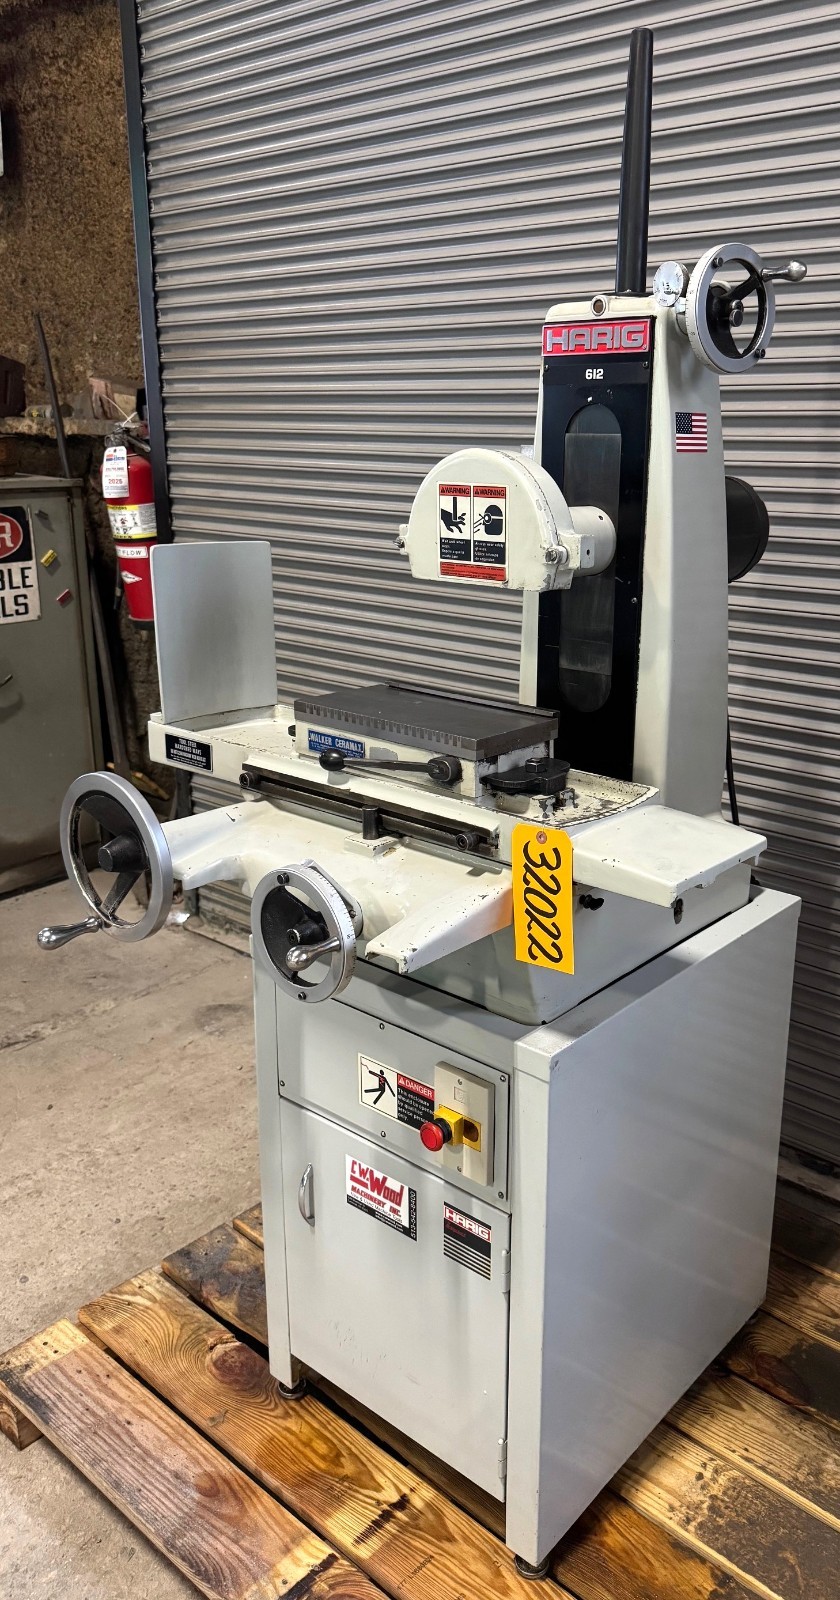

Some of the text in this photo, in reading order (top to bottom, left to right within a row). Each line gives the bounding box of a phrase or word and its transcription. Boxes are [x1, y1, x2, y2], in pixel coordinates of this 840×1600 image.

[547, 324, 644, 352] HARIG
[585, 368, 604, 380] 612
[444, 487, 470, 495] WARNING
[479, 488, 505, 497] WARNING
[310, 732, 332, 746] WALKER
[335, 738, 362, 752] CERAMAX
[522, 840, 563, 964] 32022
[405, 1079, 433, 1098] DANGER
[369, 1169, 404, 1207] Wood
[351, 1185, 387, 1208] MACHINERY
[389, 1205, 402, 1218] INC.
[445, 1208, 489, 1241] HARIG
